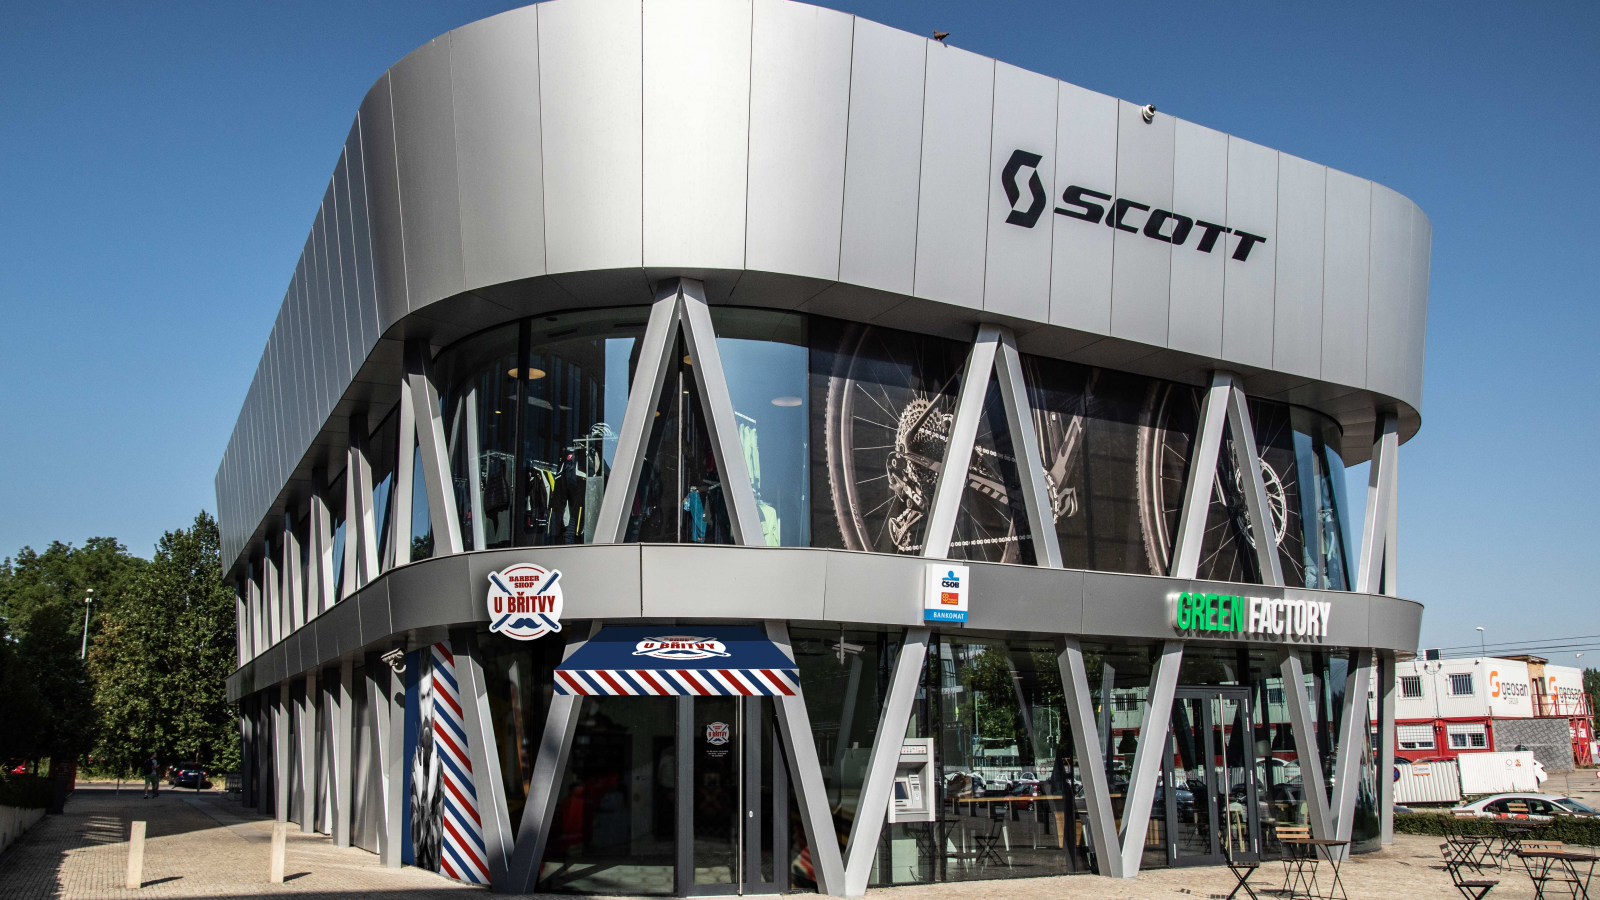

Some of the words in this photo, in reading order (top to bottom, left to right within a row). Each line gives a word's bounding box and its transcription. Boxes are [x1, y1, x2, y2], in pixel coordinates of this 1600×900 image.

[1053, 185, 1267, 262] SCOTT
[941, 580, 960, 588] ČSOB
[494, 596, 503, 613] U
[507, 591, 556, 613] BŘITVY
[933, 611, 965, 620] BANKOMAT
[1176, 591, 1244, 632] GREEN
[1248, 597, 1332, 637] FACTORY
[659, 641, 715, 650] BŘITVY
[1501, 682, 1528, 700] geosan
